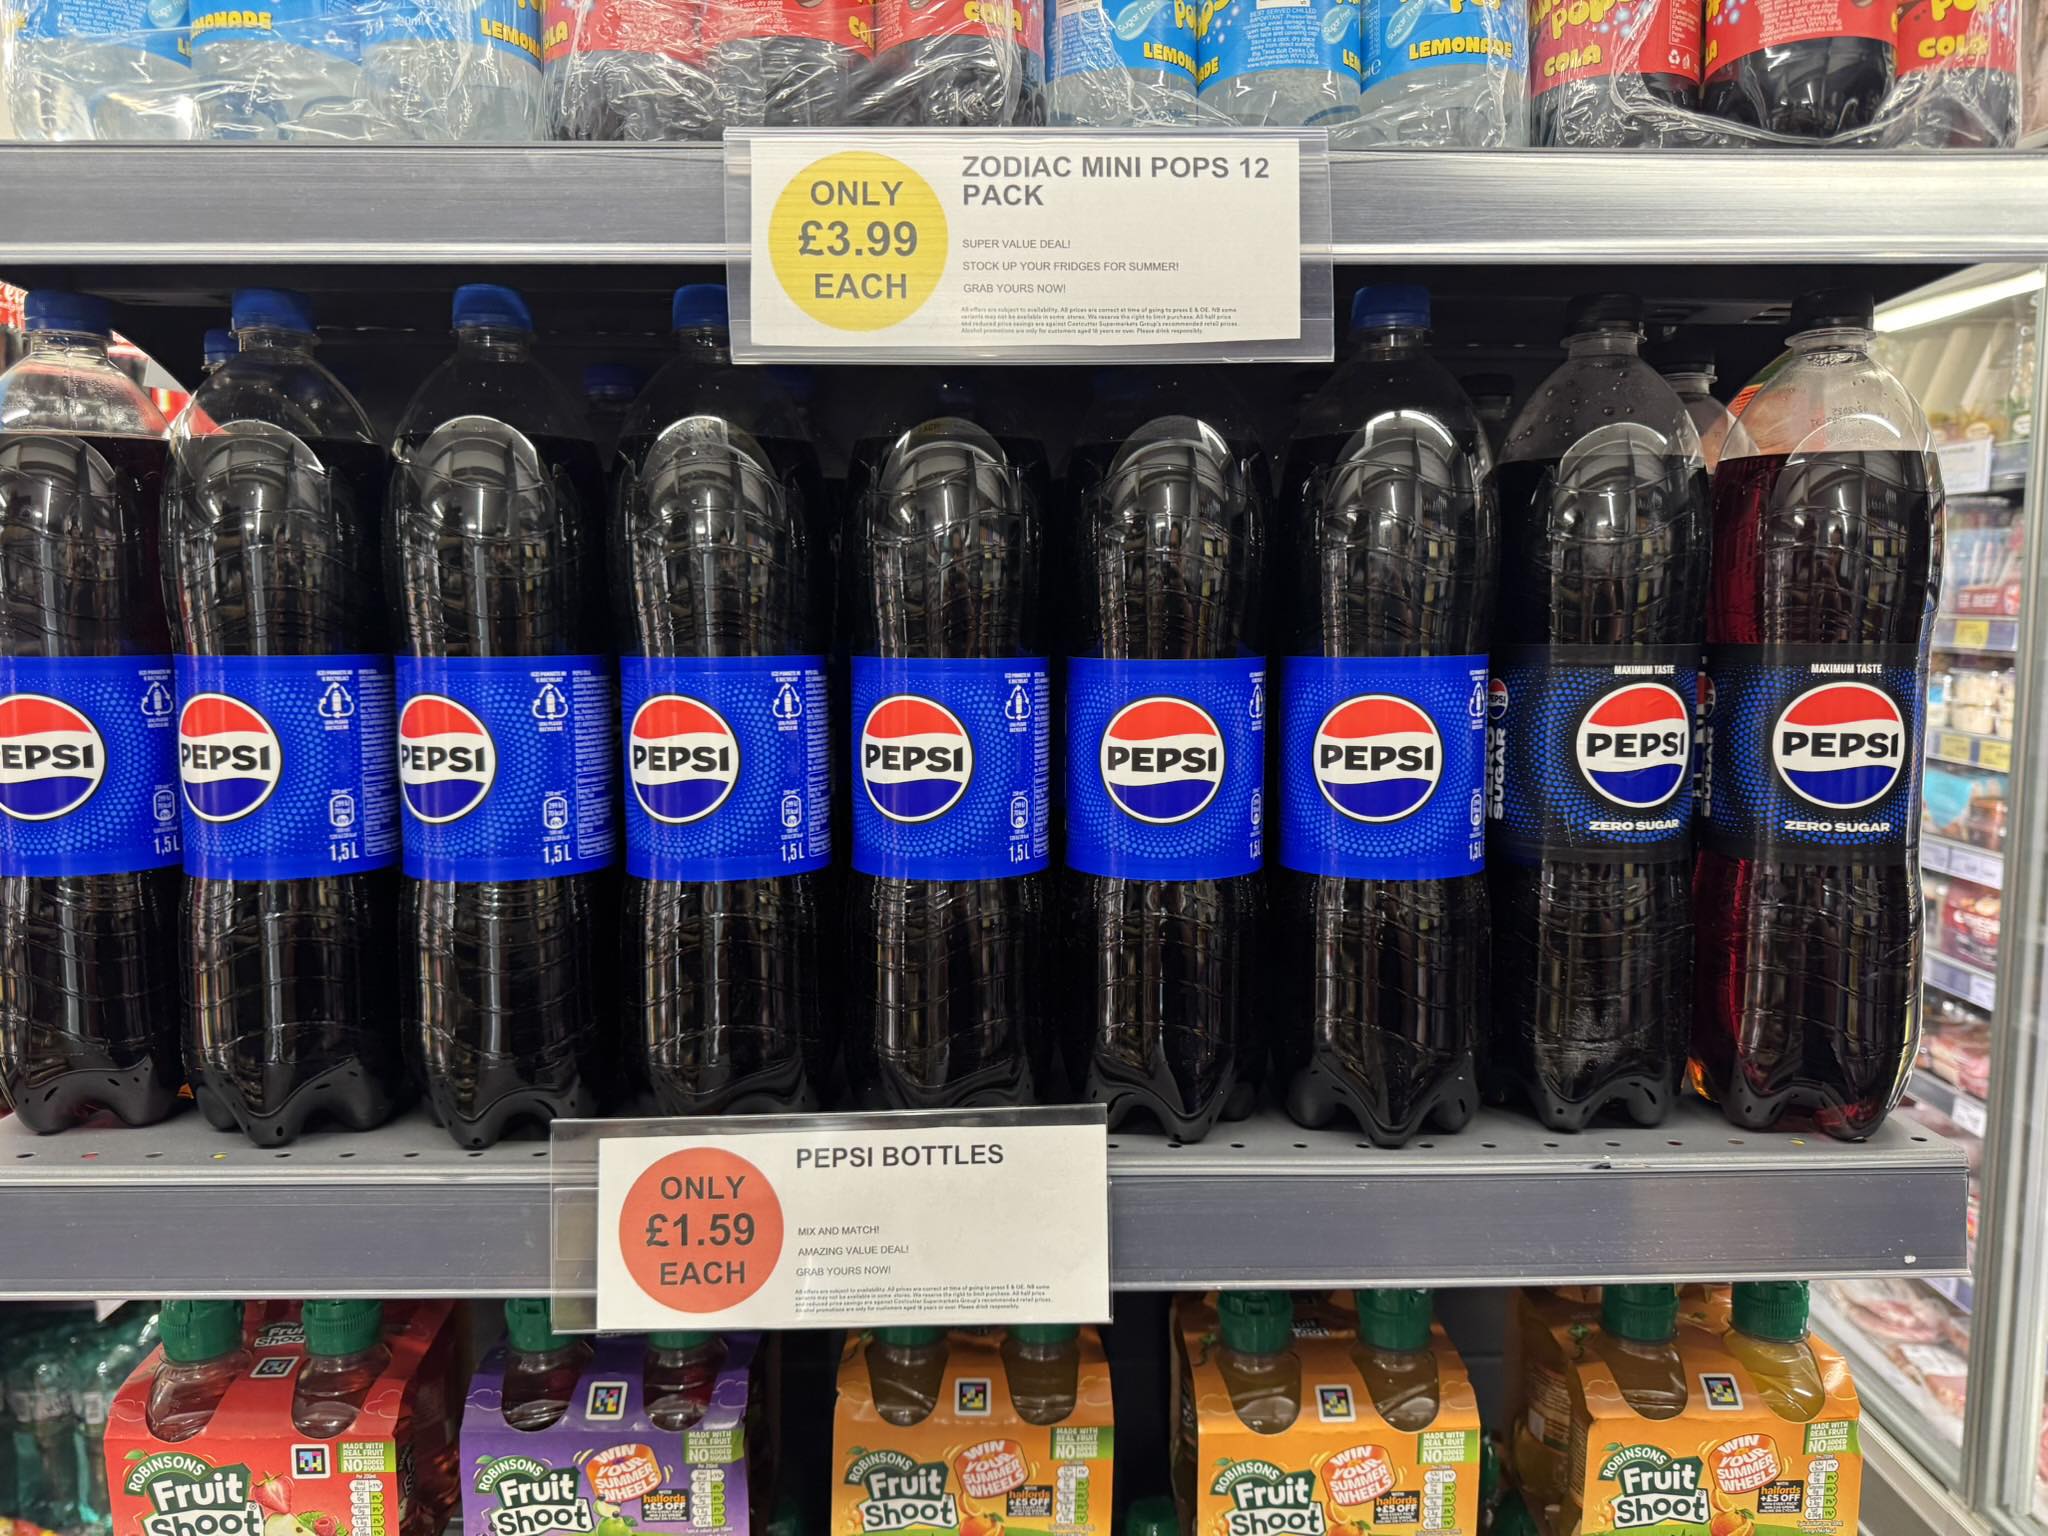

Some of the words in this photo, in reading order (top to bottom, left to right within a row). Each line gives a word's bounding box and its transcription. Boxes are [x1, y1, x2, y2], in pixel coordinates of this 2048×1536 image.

[1409, 37, 1513, 61] LEMONADE
[1917, 34, 1990, 59] COLA
[1544, 45, 1602, 77] COLA
[962, 156, 1072, 178] ZODIAC
[1082, 156, 1141, 178] MINI
[1151, 156, 1230, 179] POPS
[1240, 157, 1270, 178] 12
[810, 180, 904, 207] ONLY
[963, 185, 1044, 206] PACK
[797, 220, 918, 257] £3.99
[962, 239, 999, 249] SUPER
[1002, 239, 1037, 249] VALUE
[1040, 239, 1071, 249] DEAL!
[963, 262, 1000, 271] STOCK
[1003, 262, 1018, 271] UP
[1020, 262, 1050, 271] YOUR
[1054, 262, 1101, 272] FRIDGES
[1103, 262, 1127, 272] FOR
[1129, 262, 1179, 272] SUMMER!
[814, 272, 907, 300] EACH
[963, 284, 994, 293] GRAB
[996, 284, 1034, 294] YOURS
[1036, 284, 1066, 294] NOW!
[1614, 665, 1653, 676] MAXIMUM
[1655, 664, 1675, 675] TASTE
[1811, 663, 1855, 675] MAXIMUM
[1857, 663, 1882, 675] TASTE
[0, 744, 95, 770] EPSI
[181, 743, 271, 771] PEPSI
[865, 743, 963, 772] PEPSI
[1586, 731, 1685, 758] PEPSI
[1782, 731, 1899, 759] PEPSI
[401, 744, 486, 773] PEPSI
[634, 745, 730, 773] PEPSI
[1107, 746, 1217, 773] PEPSI
[1320, 744, 1434, 772] PEPSI
[1493, 728, 1506, 820] SUGAR
[1588, 820, 1632, 832] ZERO
[1635, 819, 1680, 831] SUGAR
[1784, 820, 1832, 832] ZERO
[1834, 822, 1891, 833] SUGAR
[796, 1146, 873, 1169] PEPSI
[882, 1143, 1004, 1167] BOTTLES
[660, 1175, 746, 1201] ONLY
[645, 1212, 755, 1247] £1.59
[797, 1227, 816, 1236] MIX
[818, 1227, 840, 1236] AND
[842, 1226, 880, 1235] MATCH!
[797, 1247, 844, 1257] AMAZING
[846, 1246, 878, 1256] VALUE
[880, 1245, 909, 1255] DEAL!
[660, 1260, 745, 1286] EACH
[796, 1267, 825, 1277] GRAB
[827, 1266, 862, 1276] YOURS
[864, 1265, 892, 1275] NOW!
[255, 1335, 305, 1346] Shoo
[268, 1325, 305, 1337] Frui
[1446, 1431, 1465, 1439] WITH
[1831, 1421, 1848, 1429] WITH
[594, 1444, 638, 1466] WIN
[689, 1448, 709, 1461] NO
[963, 1440, 1006, 1460] WIN
[1332, 1445, 1373, 1467] WIN
[1423, 1449, 1442, 1463] NO
[1718, 1434, 1760, 1455] WIN
[1720, 1447, 1769, 1467] YOUR
[1809, 1440, 1826, 1453] NO
[129, 1456, 206, 1493] ROBINSONS
[343, 1459, 363, 1472] NO
[478, 1458, 544, 1492] ROBINSONS
[596, 1456, 648, 1478] YOUR
[849, 1452, 914, 1483] ROBINSONS
[962, 1460, 1021, 1485] SUMMER
[964, 1454, 1015, 1473] YOUR
[1331, 1458, 1383, 1480] YOUR
[1602, 1447, 1668, 1478] ROBINSONS
[1717, 1454, 1774, 1480] SUMMER
[499, 1472, 575, 1505] Fruit
[594, 1463, 653, 1490] SUMMER
[598, 1472, 659, 1503] WHEELS
[869, 1468, 942, 1498] Fruit
[964, 1468, 1026, 1498] WHEELS
[1214, 1463, 1280, 1494] ROBINSONS
[1330, 1466, 1388, 1492] SUMMER
[1623, 1463, 1697, 1494] Fruit
[1718, 1463, 1778, 1493] WHEELS
[152, 1471, 244, 1512] Fruit
[1029, 1498, 1050, 1506] OFF
[1236, 1478, 1310, 1509] Fruit
[1332, 1475, 1392, 1505] WHEELS
[1781, 1494, 1801, 1502] OFF
[496, 1502, 591, 1535] Shoot
[664, 1502, 686, 1510] OFF
[864, 1500, 954, 1528] Shoot
[1396, 1504, 1417, 1512] OFF
[1617, 1494, 1706, 1524] Shoot
[150, 1505, 262, 1536] Shoot
[1231, 1511, 1321, 1536] Shoot
